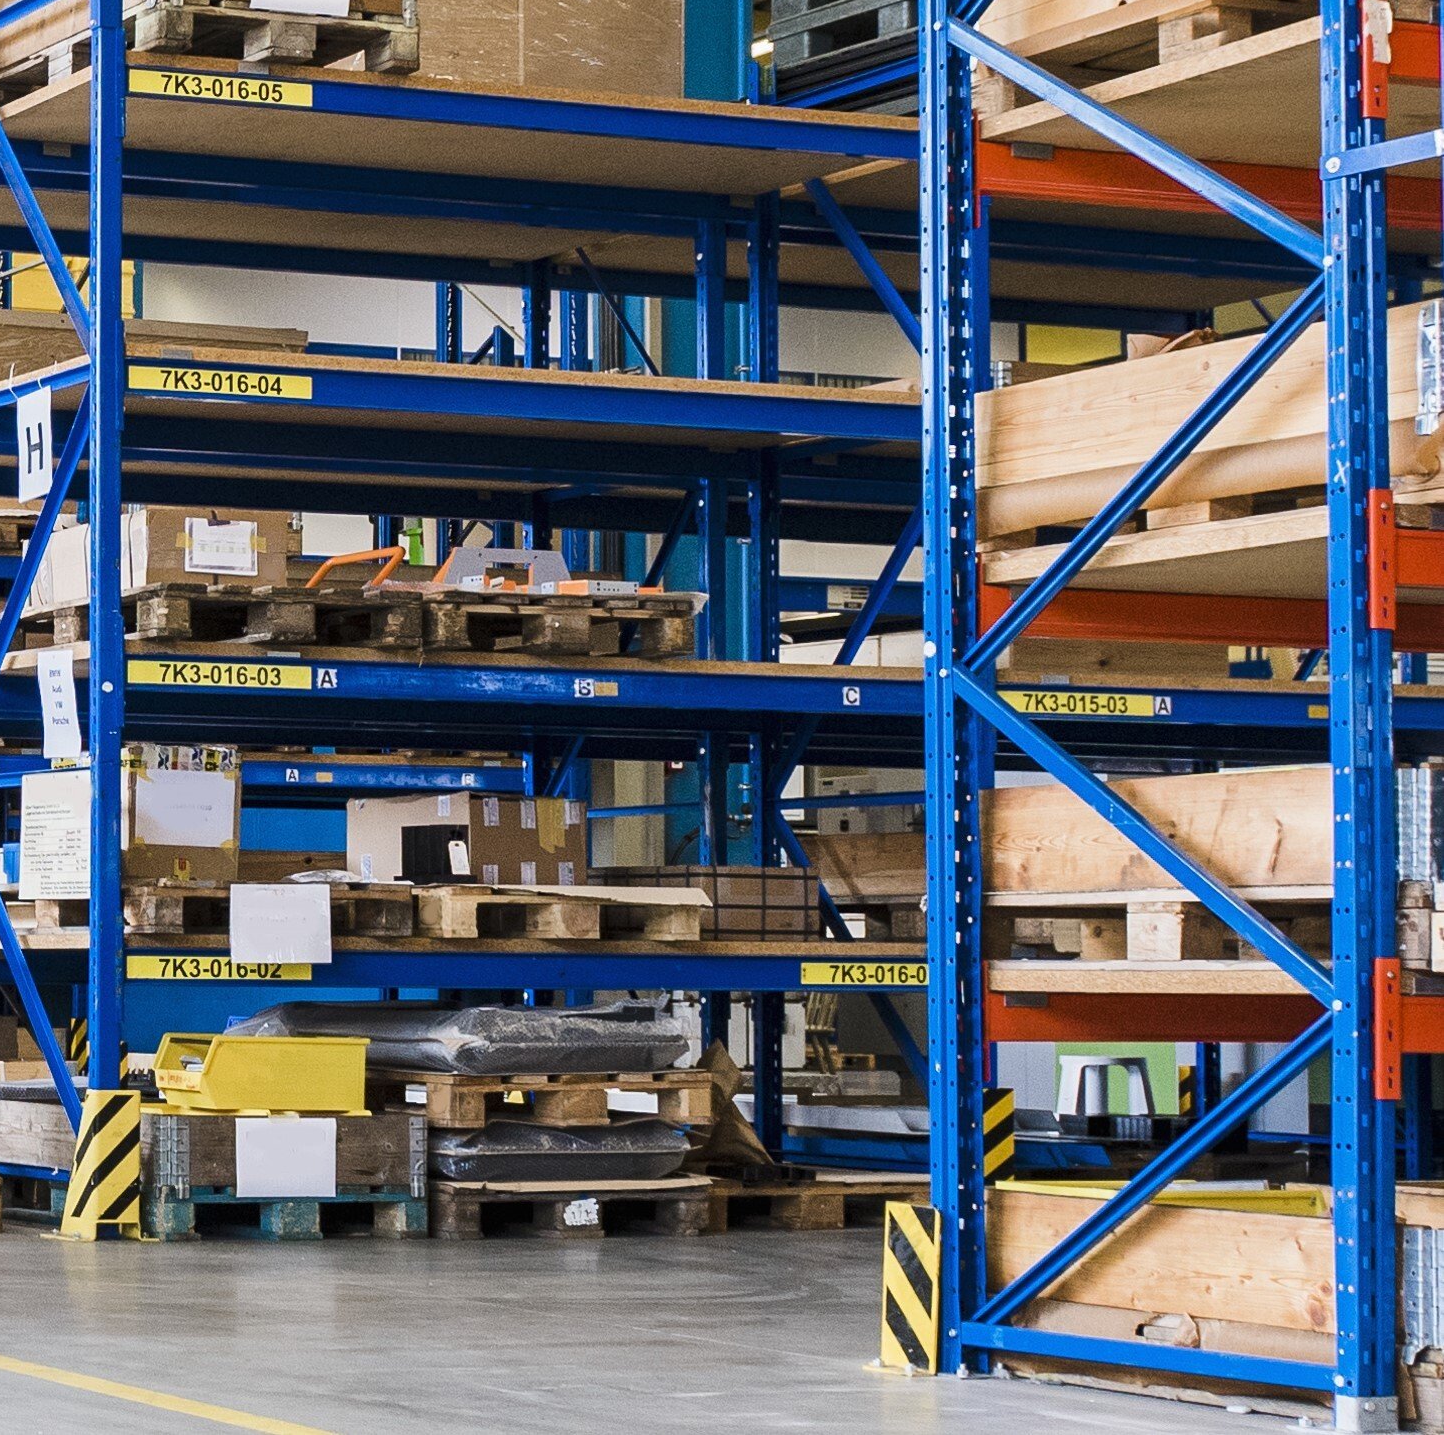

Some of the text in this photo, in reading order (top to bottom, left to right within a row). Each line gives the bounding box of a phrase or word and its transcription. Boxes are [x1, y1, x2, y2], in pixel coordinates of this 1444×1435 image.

[161, 74, 283, 102] 7K3-016-05
[160, 370, 283, 395] 7K3-016-04
[25, 422, 44, 474] H
[159, 664, 282, 686] 7K3-016-03
[320, 670, 334, 687] A
[845, 687, 858, 704] C
[1022, 693, 1128, 713] 7K3-015-03
[1157, 699, 1169, 714] A
[287, 769, 297, 780] A
[158, 958, 282, 978] 7K3-016-02
[829, 965, 927, 983] 7K3-016-0
